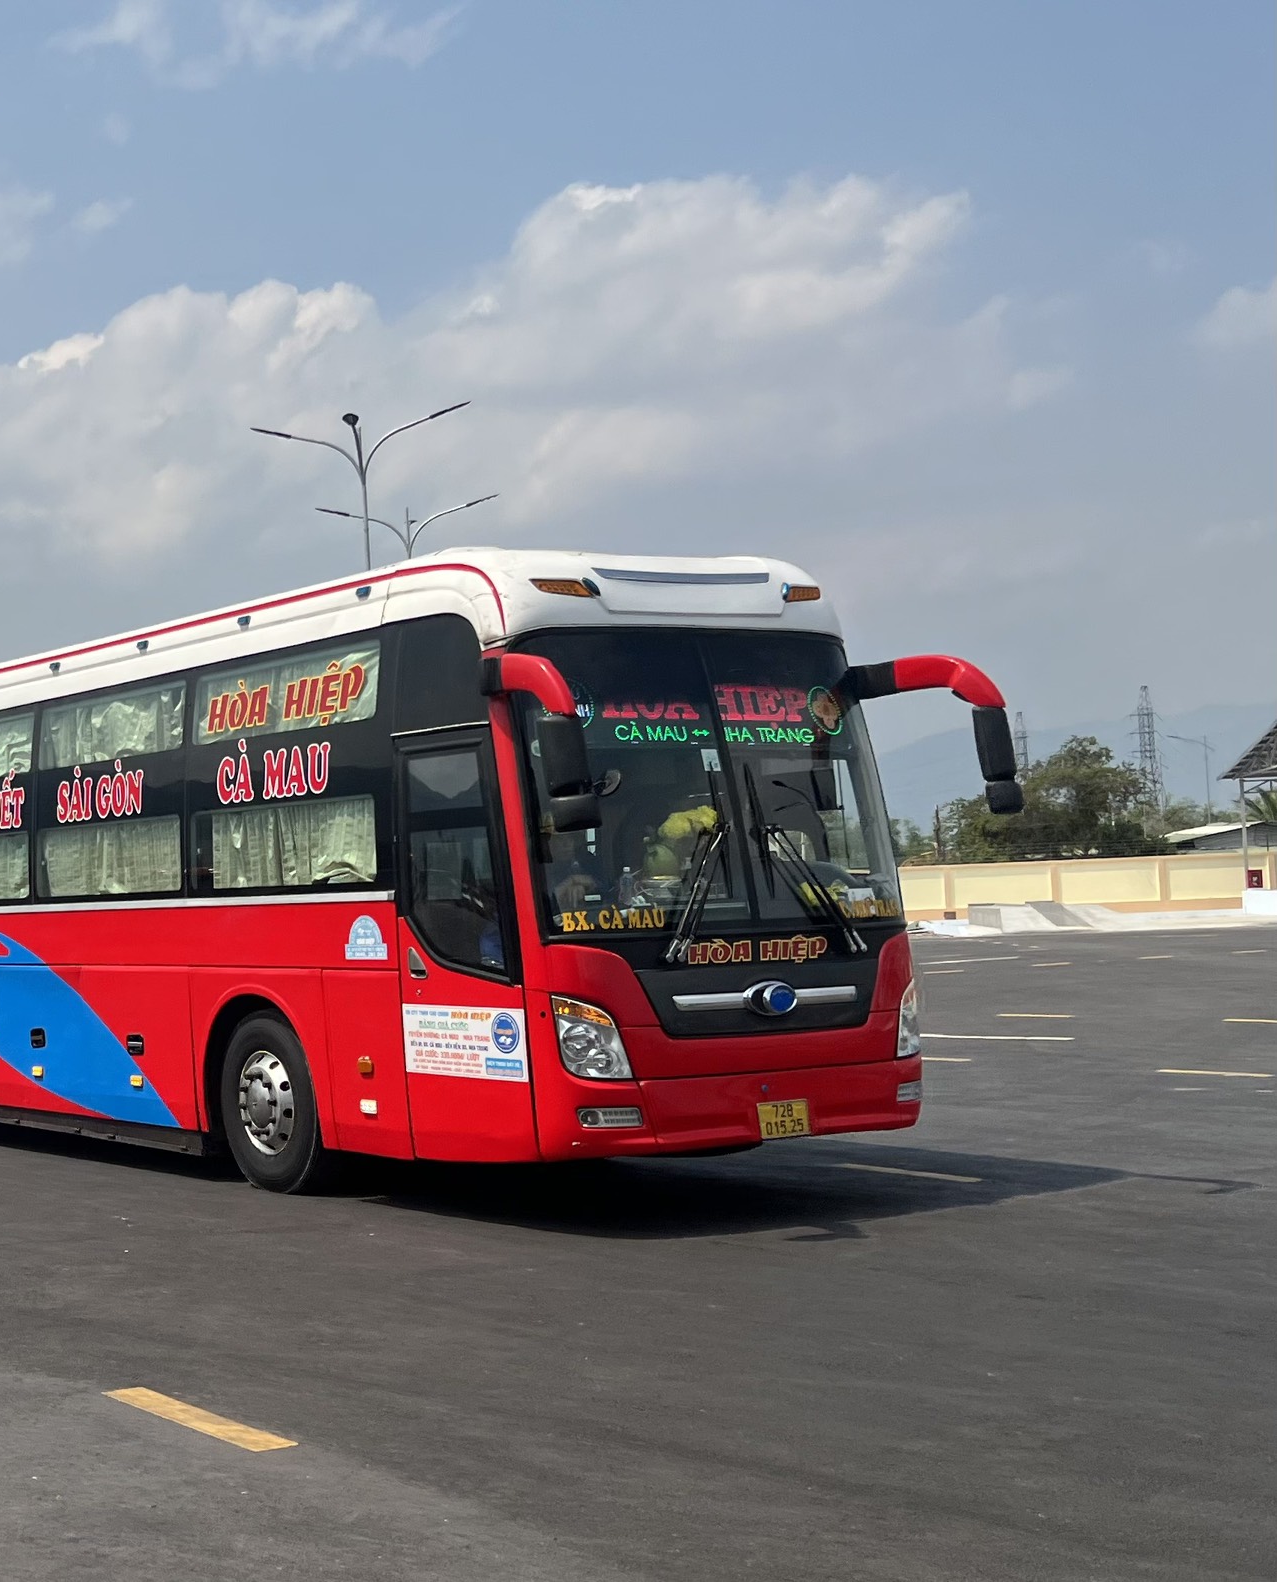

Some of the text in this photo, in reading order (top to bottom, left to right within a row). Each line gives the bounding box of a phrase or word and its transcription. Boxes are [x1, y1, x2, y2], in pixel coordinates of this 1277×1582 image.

[207, 661, 366, 734] HÒA HIỆP
[615, 721, 644, 741] CÀ
[646, 725, 688, 742] MAU
[756, 727, 815, 743] TRANG
[216, 739, 331, 804] CÀ MAU
[57, 759, 144, 823] SÀI GÒN
[561, 904, 666, 932] BX. CÀ MAU
[688, 934, 828, 965] HÒA HIỆP
[771, 1103, 794, 1118] 72B
[765, 1118, 804, 1136] 015.25
